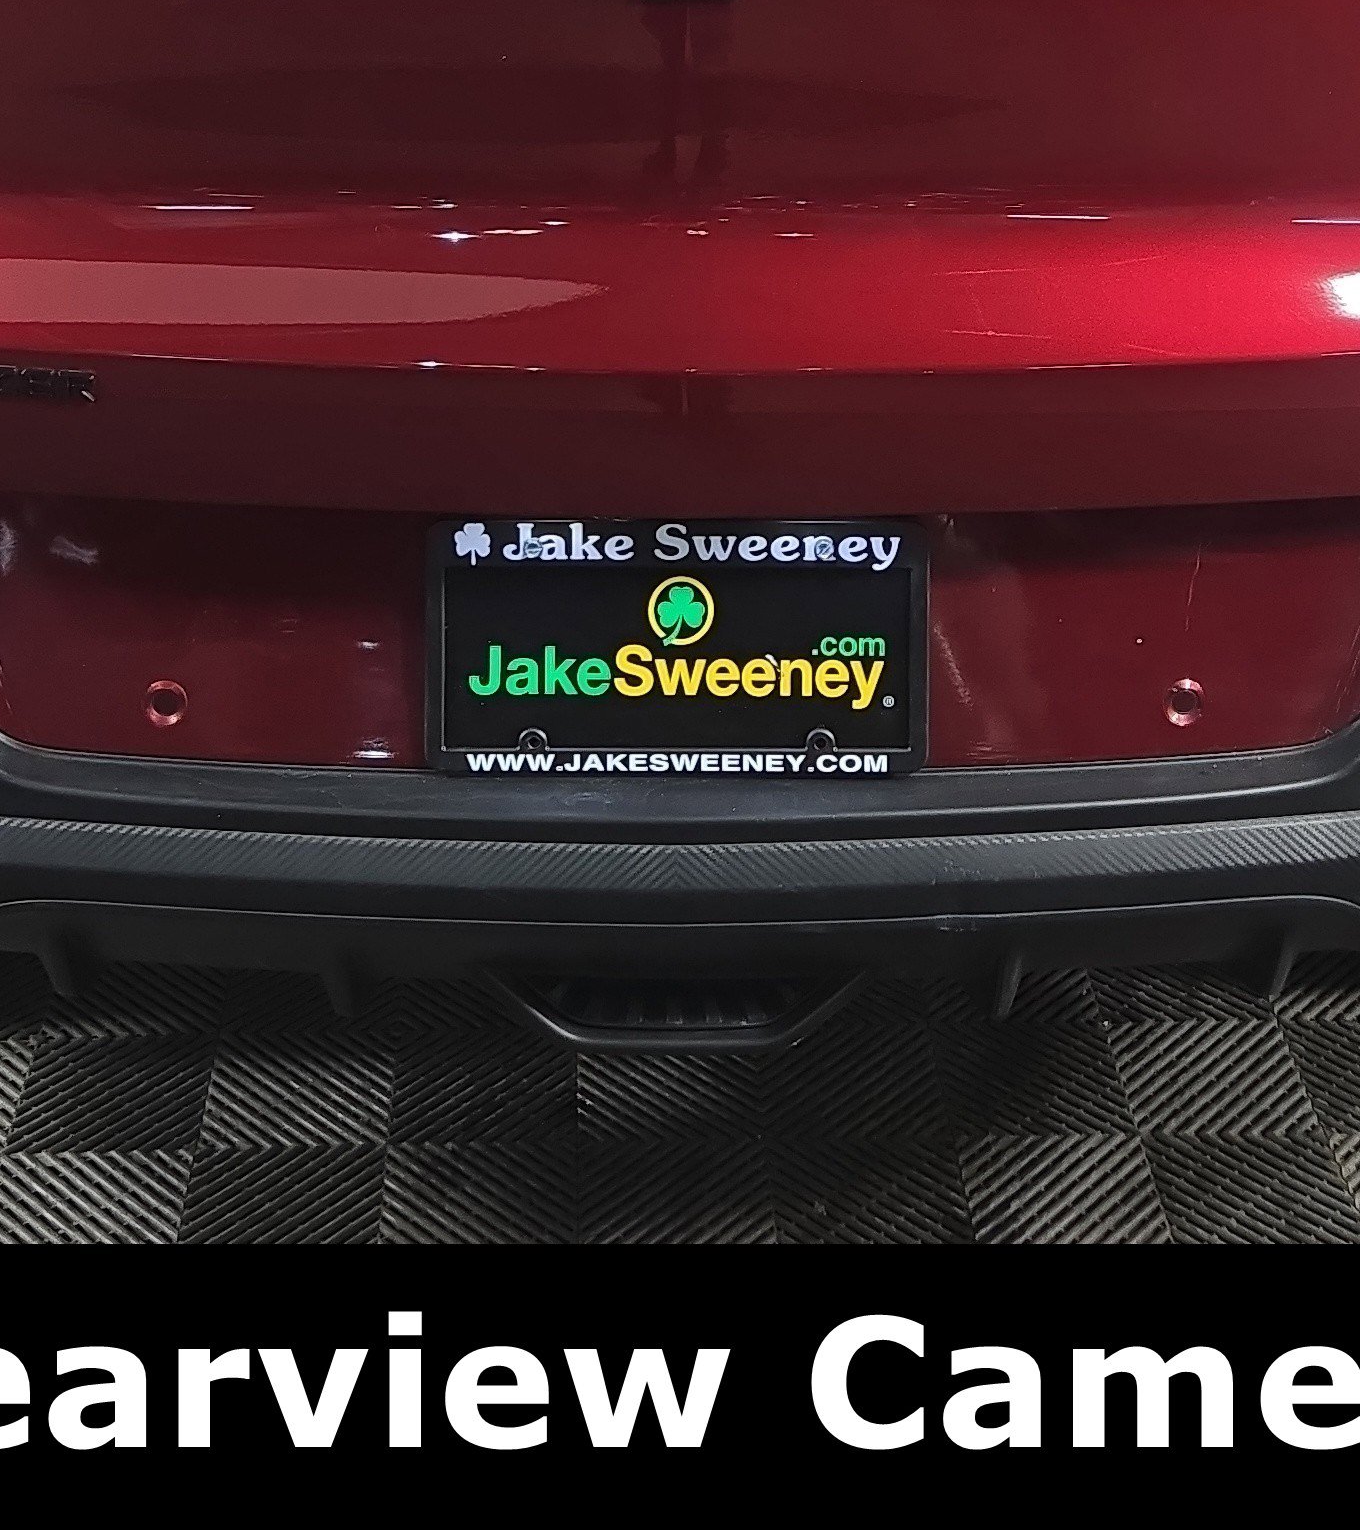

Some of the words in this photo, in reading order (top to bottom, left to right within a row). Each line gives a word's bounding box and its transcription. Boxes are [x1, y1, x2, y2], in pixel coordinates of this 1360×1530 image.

[502, 522, 635, 562] Jake
[654, 523, 901, 571] Sweeney
[465, 753, 889, 773] WWW.JAKESWEENEY.COM
